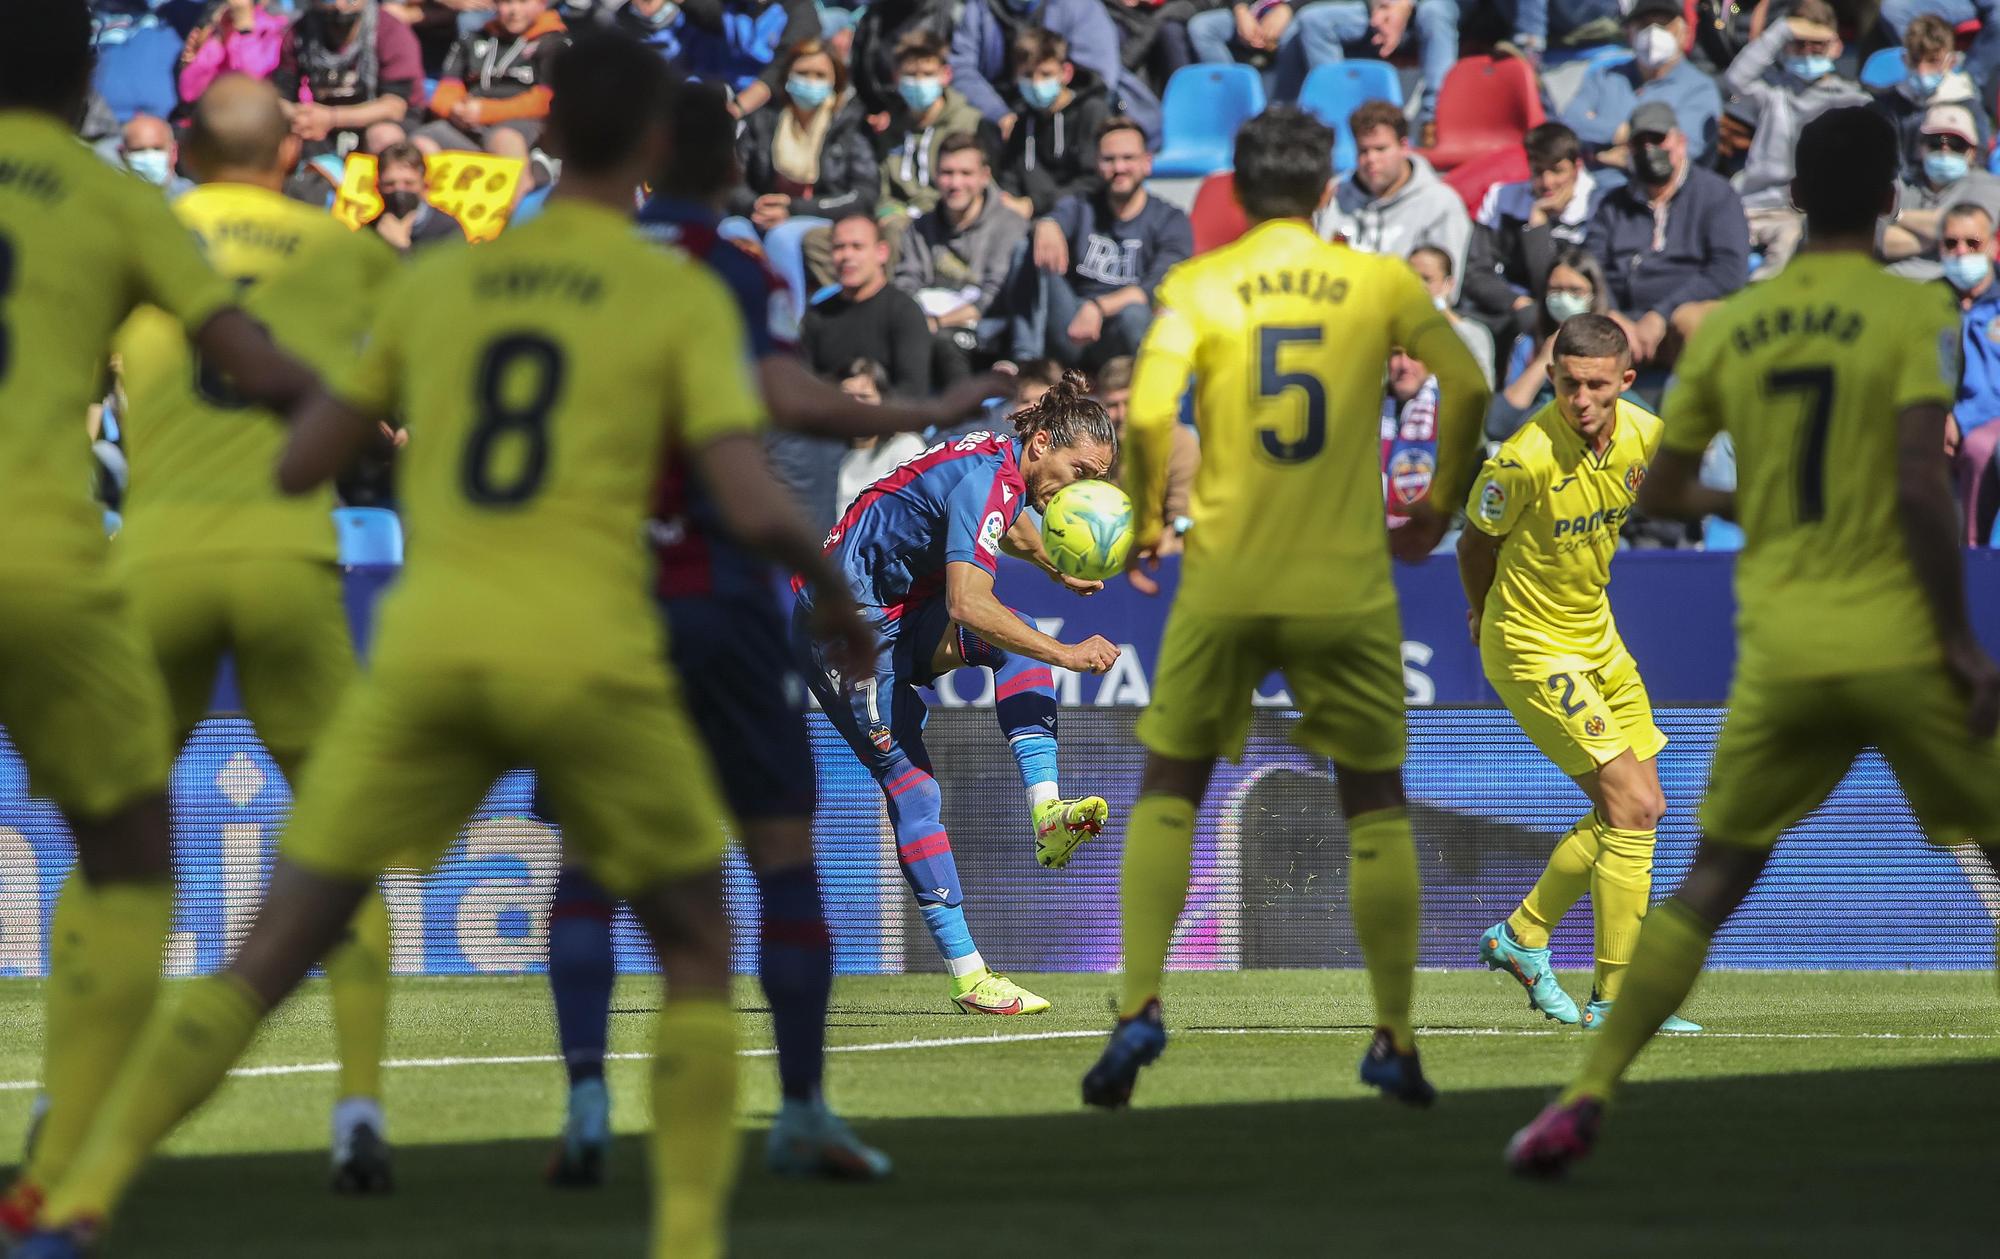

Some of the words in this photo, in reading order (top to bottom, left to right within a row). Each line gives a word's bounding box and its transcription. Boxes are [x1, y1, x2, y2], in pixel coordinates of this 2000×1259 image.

[1238, 269, 1349, 307] PAREJO
[459, 327, 567, 512] 8
[1259, 325, 1326, 464] 5
[1765, 364, 1836, 523] 7
[854, 676, 881, 724] 7
[1548, 672, 1587, 719] 2
